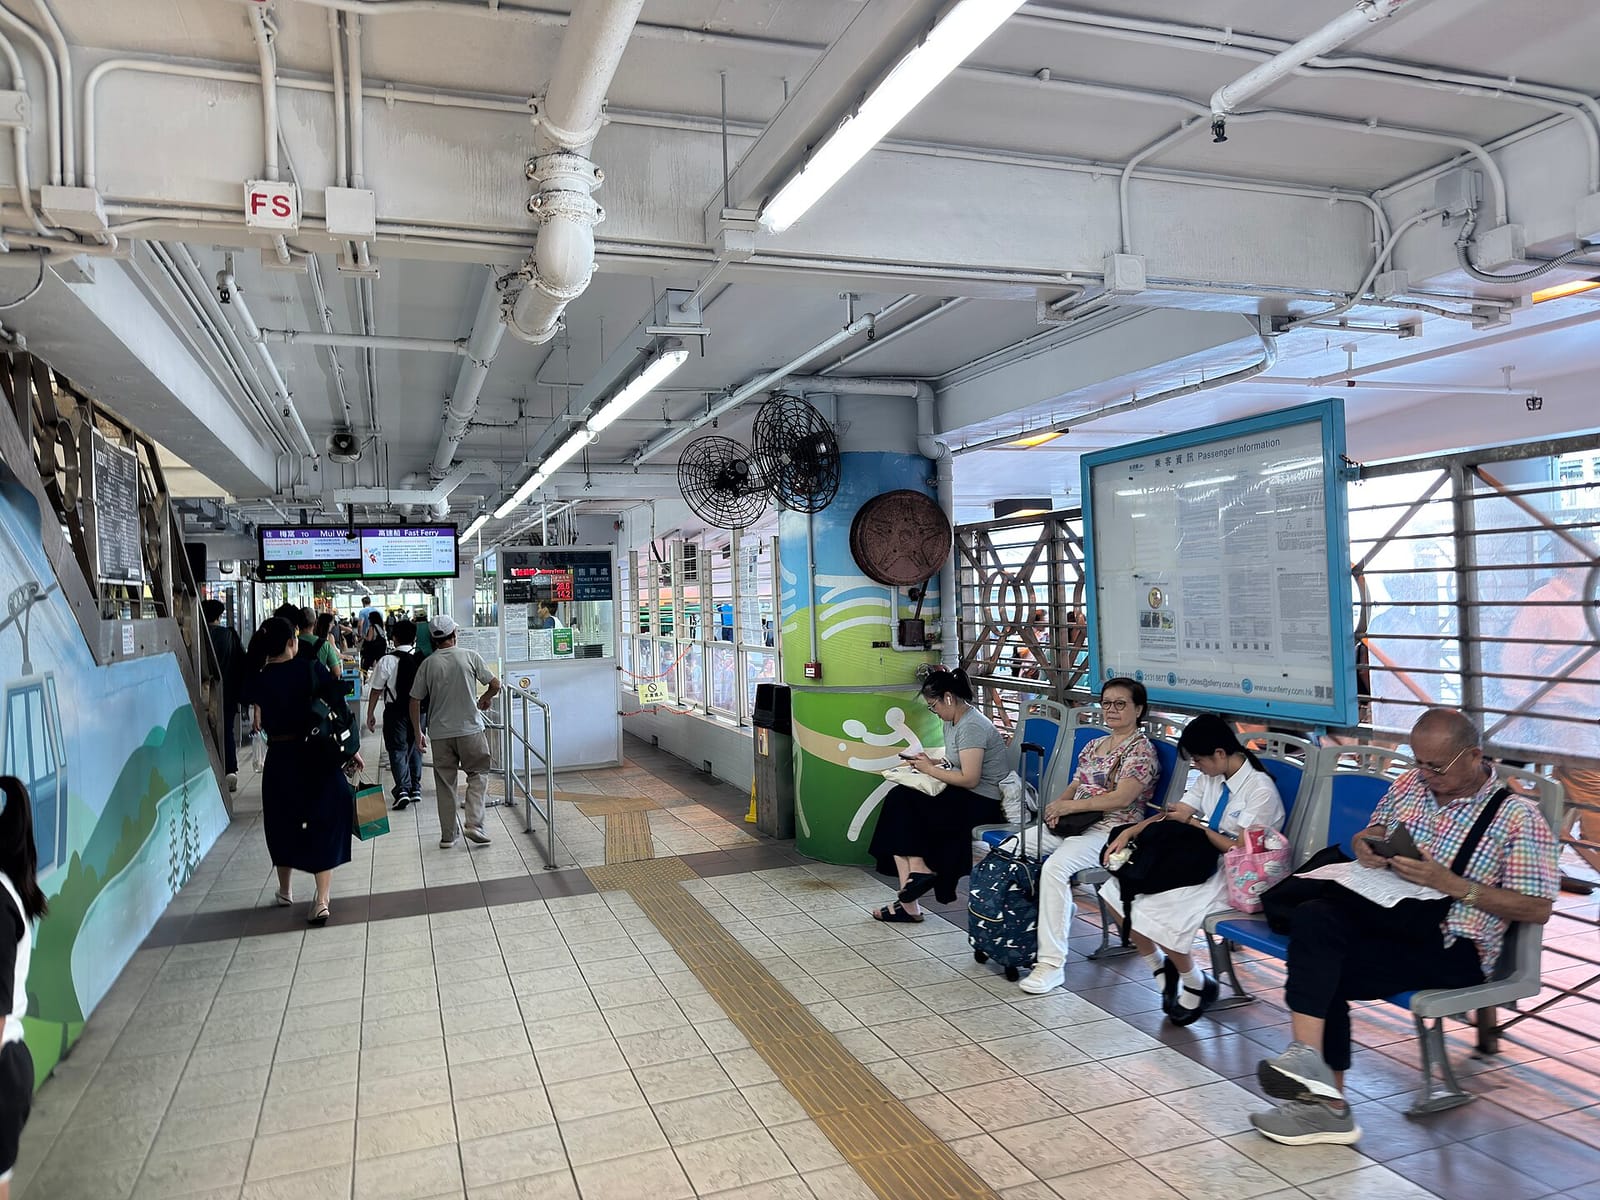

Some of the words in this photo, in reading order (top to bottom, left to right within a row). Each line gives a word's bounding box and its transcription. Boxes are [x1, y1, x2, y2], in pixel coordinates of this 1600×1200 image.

[250, 192, 292, 217] FS
[1154, 452, 1195, 468] 乘客資訊
[1197, 446, 1236, 461] Passenger
[1236, 438, 1281, 454] Information
[404, 529, 419, 537] Fast
[420, 529, 440, 538] Ferry
